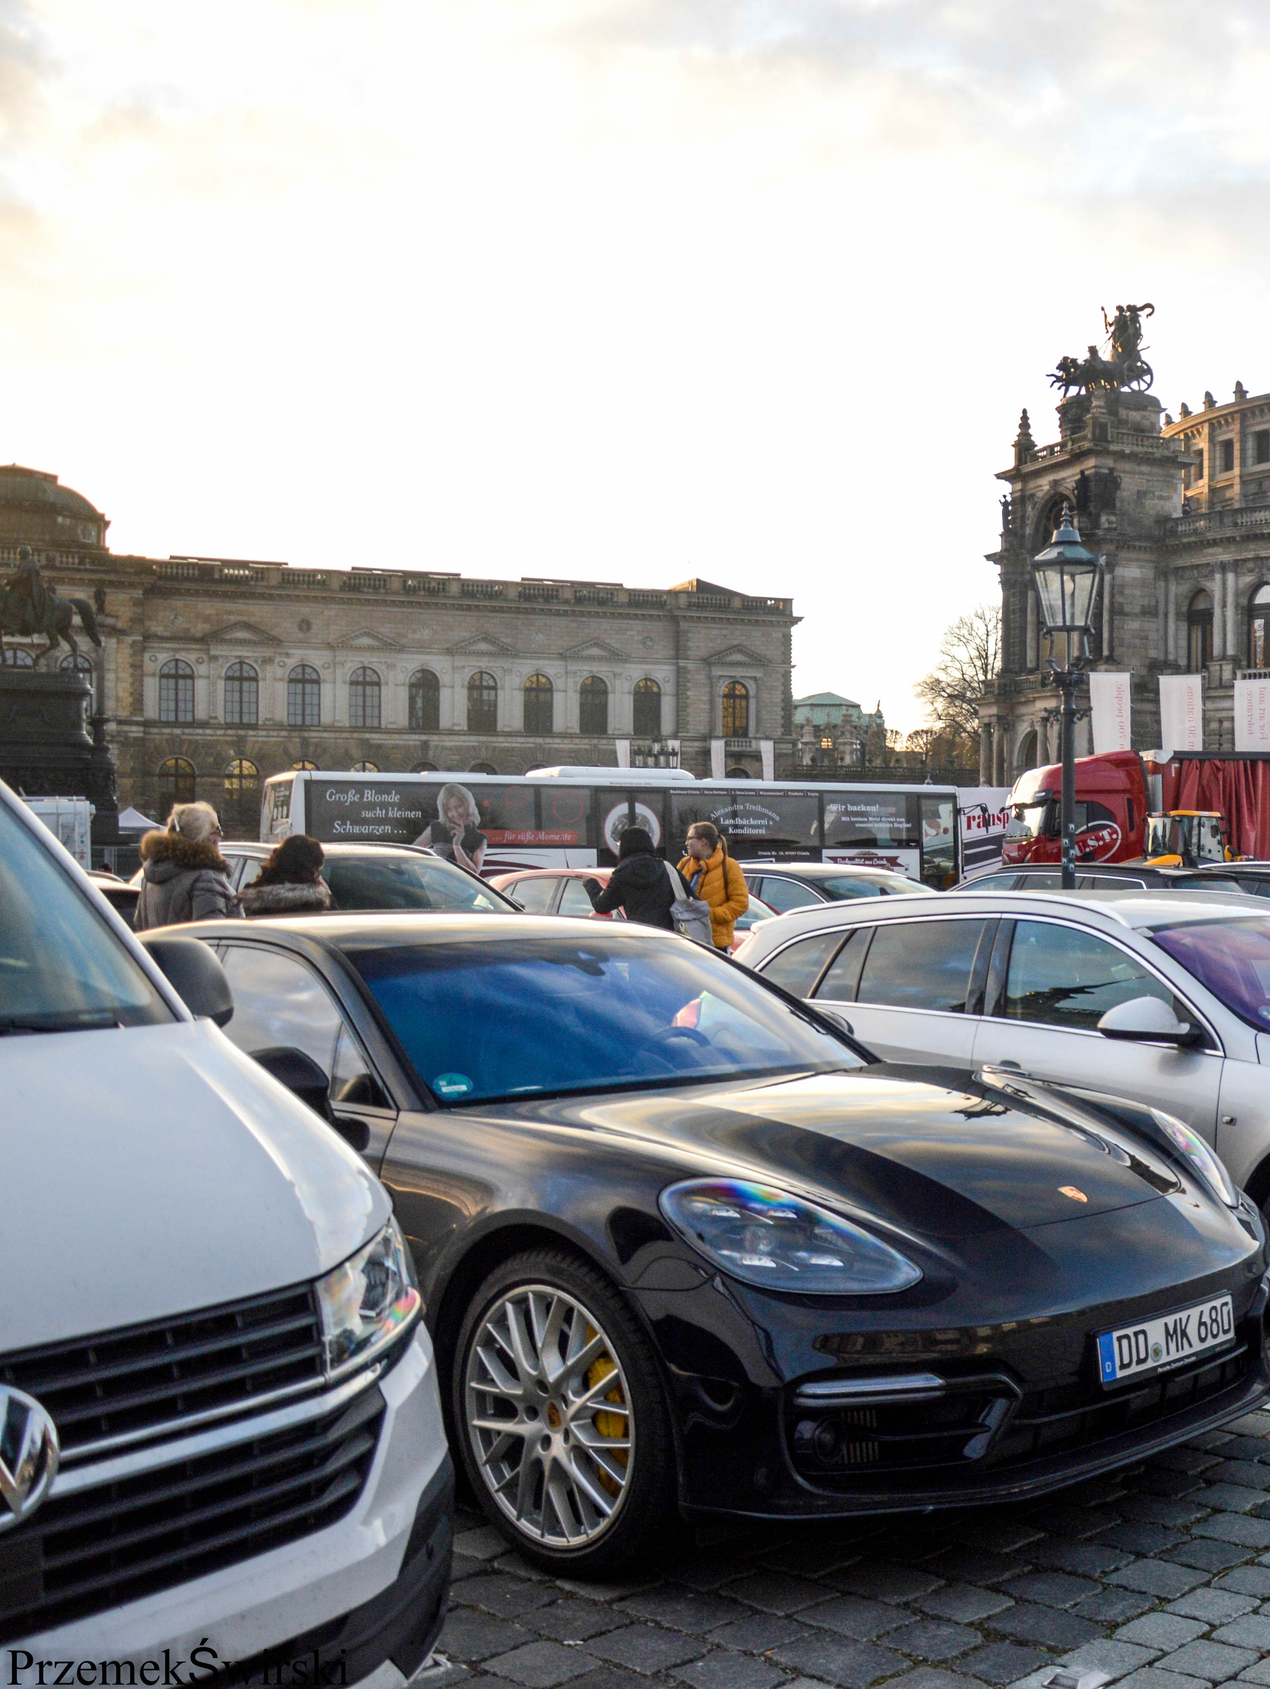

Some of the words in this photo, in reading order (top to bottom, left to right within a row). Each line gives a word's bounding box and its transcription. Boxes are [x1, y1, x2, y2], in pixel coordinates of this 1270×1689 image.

[326, 789, 360, 805] Große
[363, 789, 400, 802] Blonde
[361, 806, 386, 818] sucht
[388, 806, 422, 818] kleinen
[710, 803, 743, 820] Alexandra
[830, 803, 845, 812] Wir
[847, 804, 879, 812] backen!
[720, 817, 768, 825] Landbäckerei
[333, 820, 391, 835] Schwarzen
[728, 826, 766, 834] Konditorei
[503, 831, 516, 843] für
[517, 831, 535, 843] süße
[1116, 1329, 1150, 1371] DD
[1164, 1314, 1194, 1356] MK
[1198, 1301, 1232, 1343] 680
[1105, 1362, 1112, 1373] D
